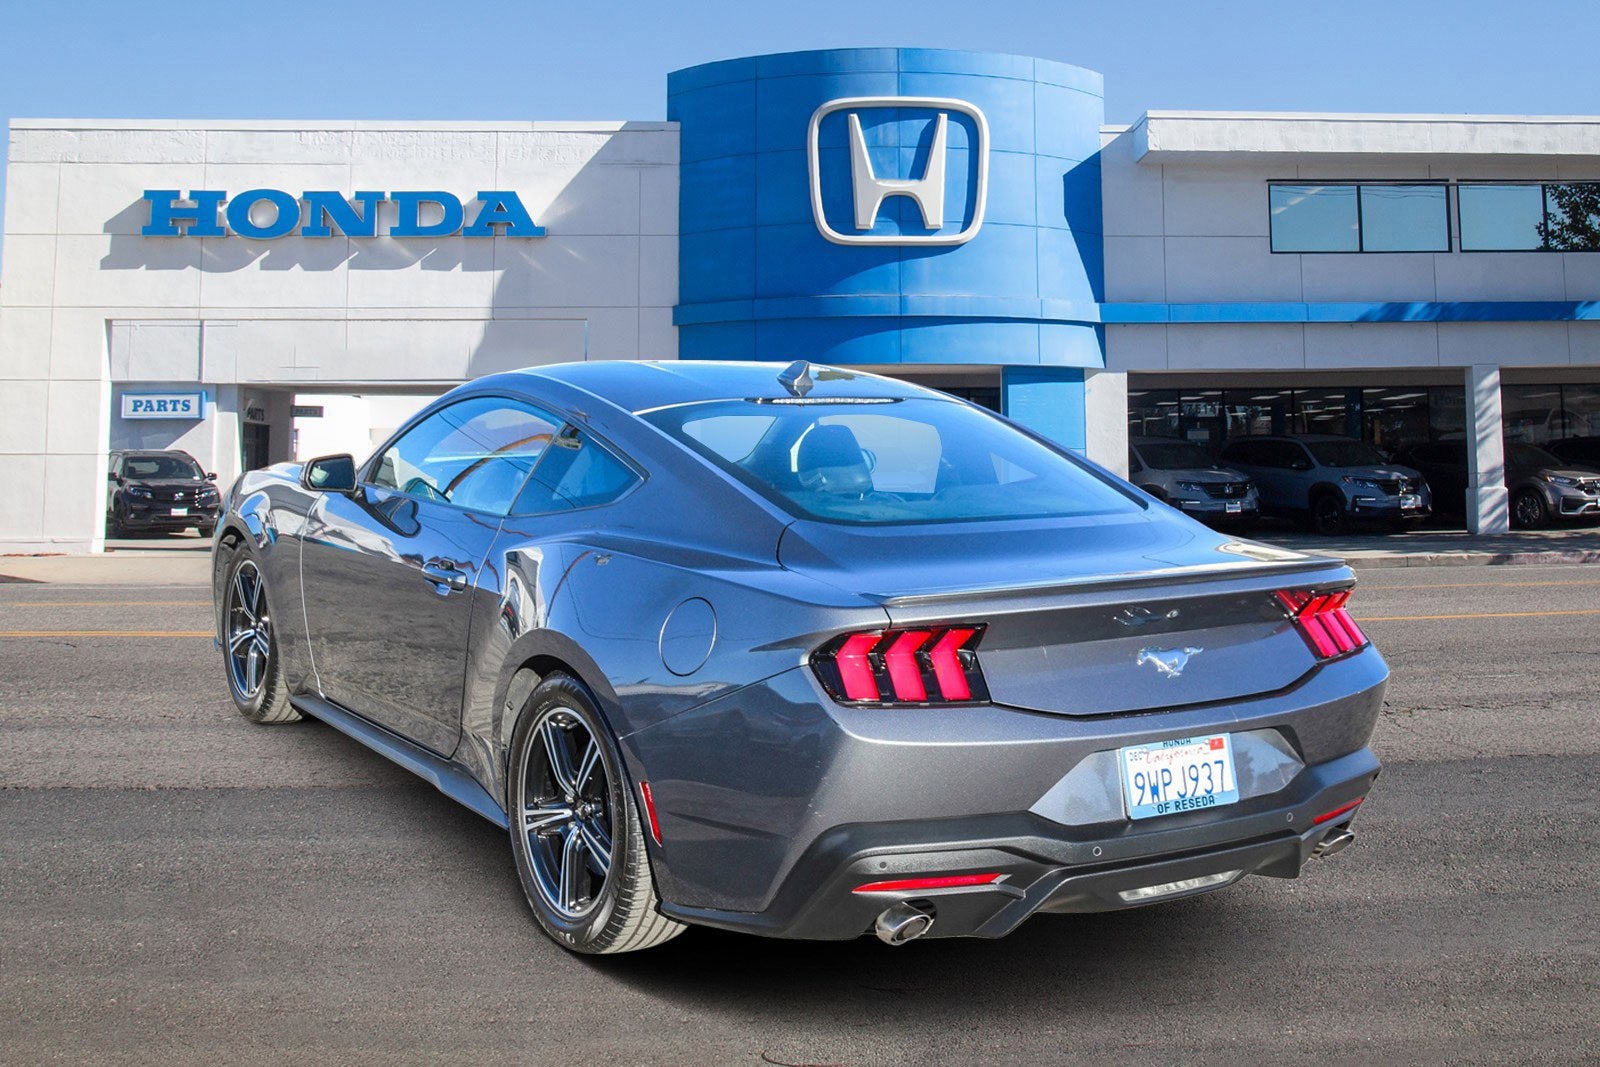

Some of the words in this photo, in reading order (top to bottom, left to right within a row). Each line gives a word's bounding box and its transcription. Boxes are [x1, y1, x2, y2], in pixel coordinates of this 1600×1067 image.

[141, 188, 548, 240] HONDA
[132, 400, 191, 412] PARTS
[1134, 760, 1225, 806] 9WPJ937
[1157, 802, 1171, 814] OF
[1175, 795, 1216, 811] RESEDA
